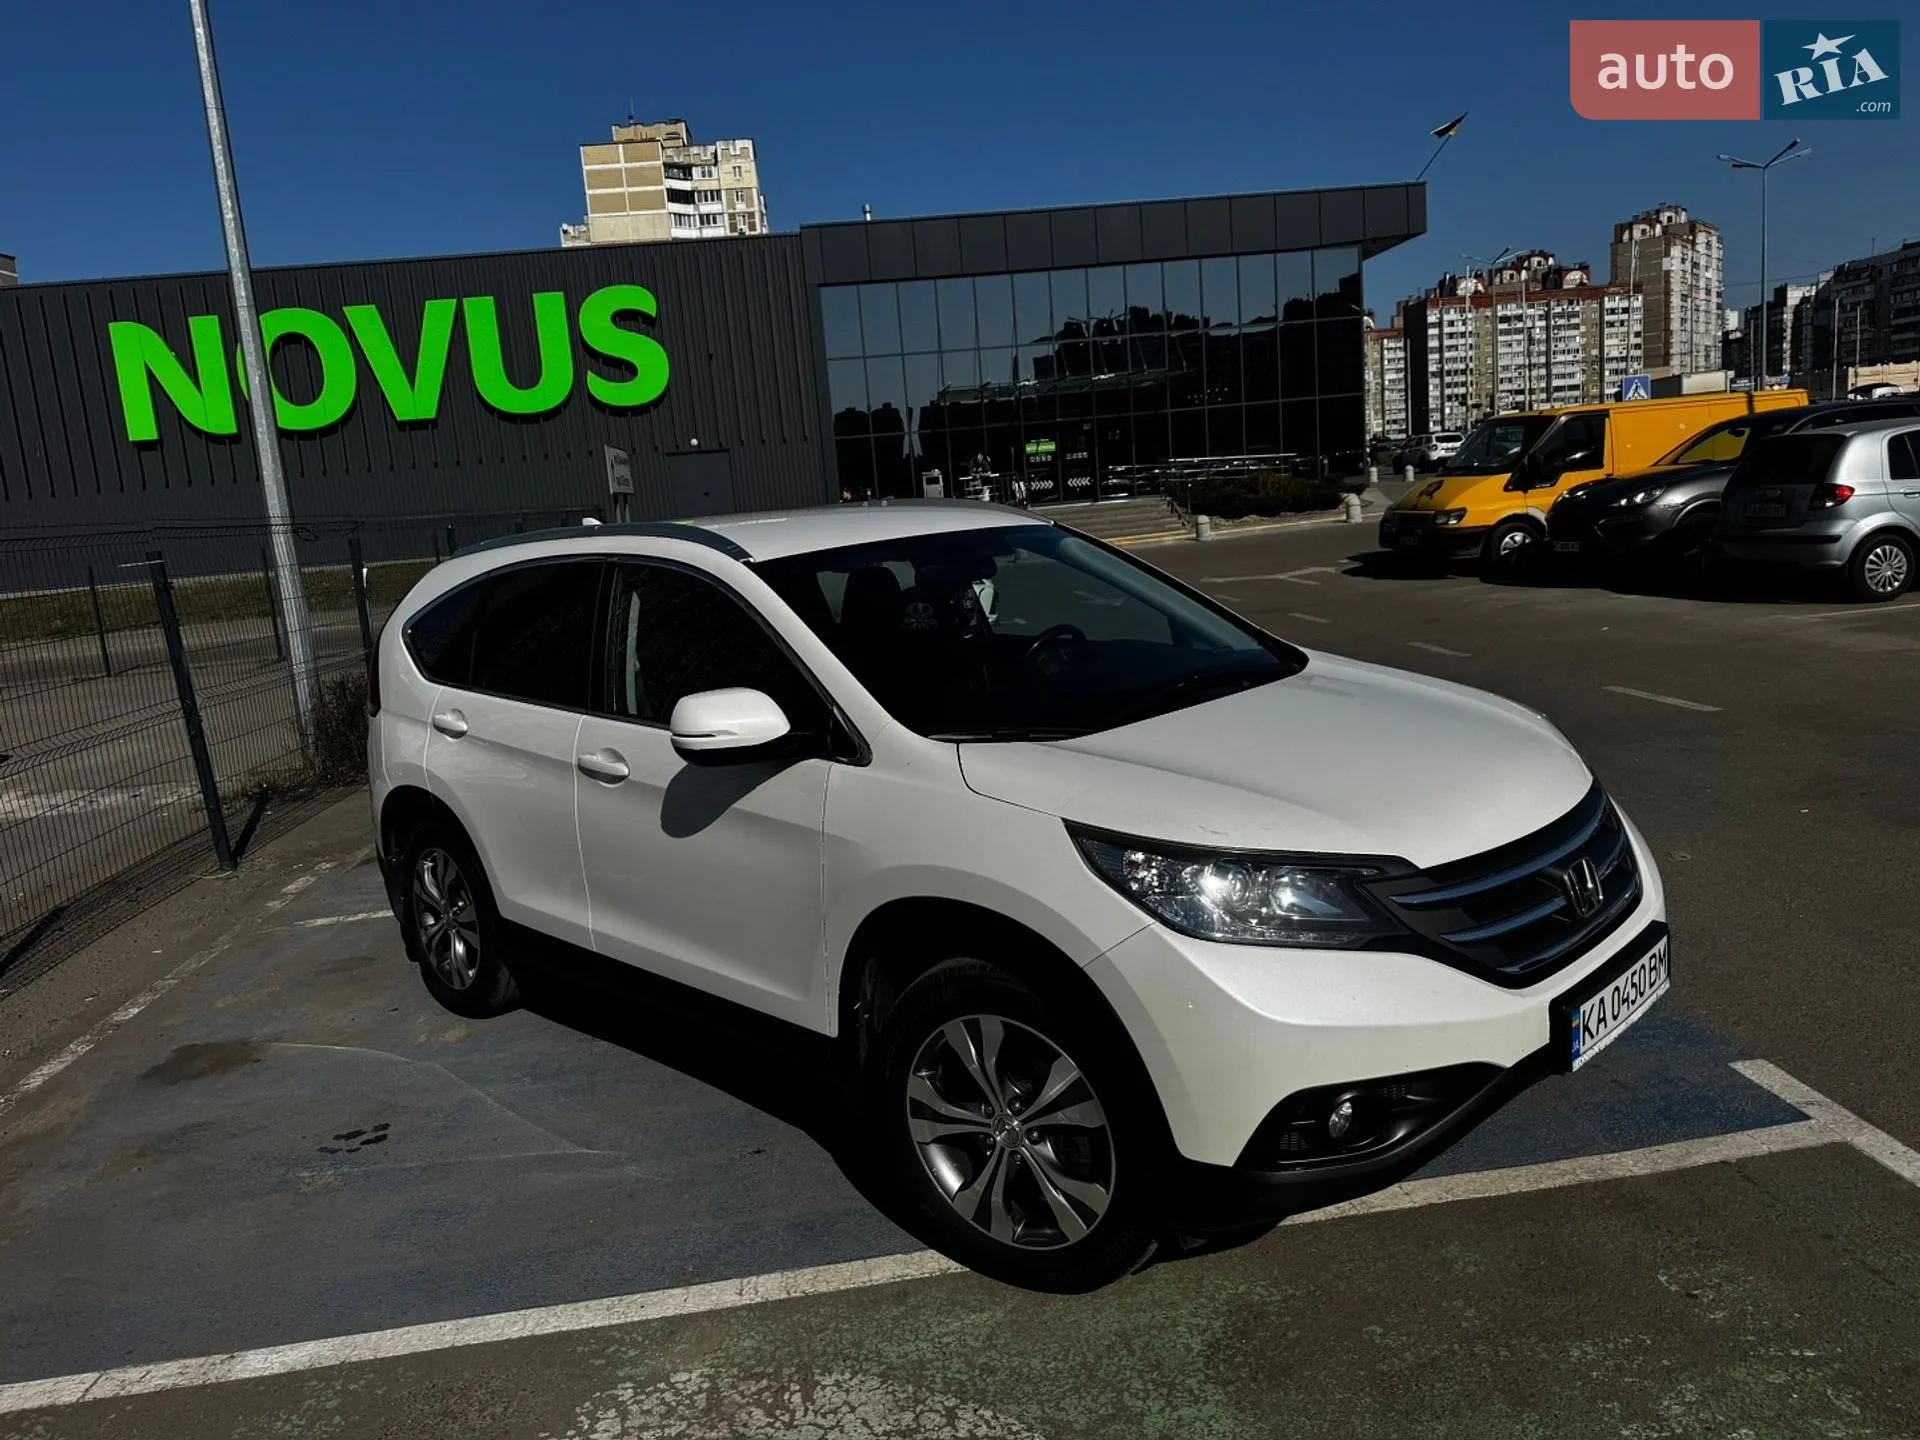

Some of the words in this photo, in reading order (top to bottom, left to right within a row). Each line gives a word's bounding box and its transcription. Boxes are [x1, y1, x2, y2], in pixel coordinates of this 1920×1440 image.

[107, 283, 671, 442] NOVUS
[1582, 996, 1608, 1046] KA
[1611, 963, 1647, 1021] 0450
[1649, 943, 1668, 991] BM
